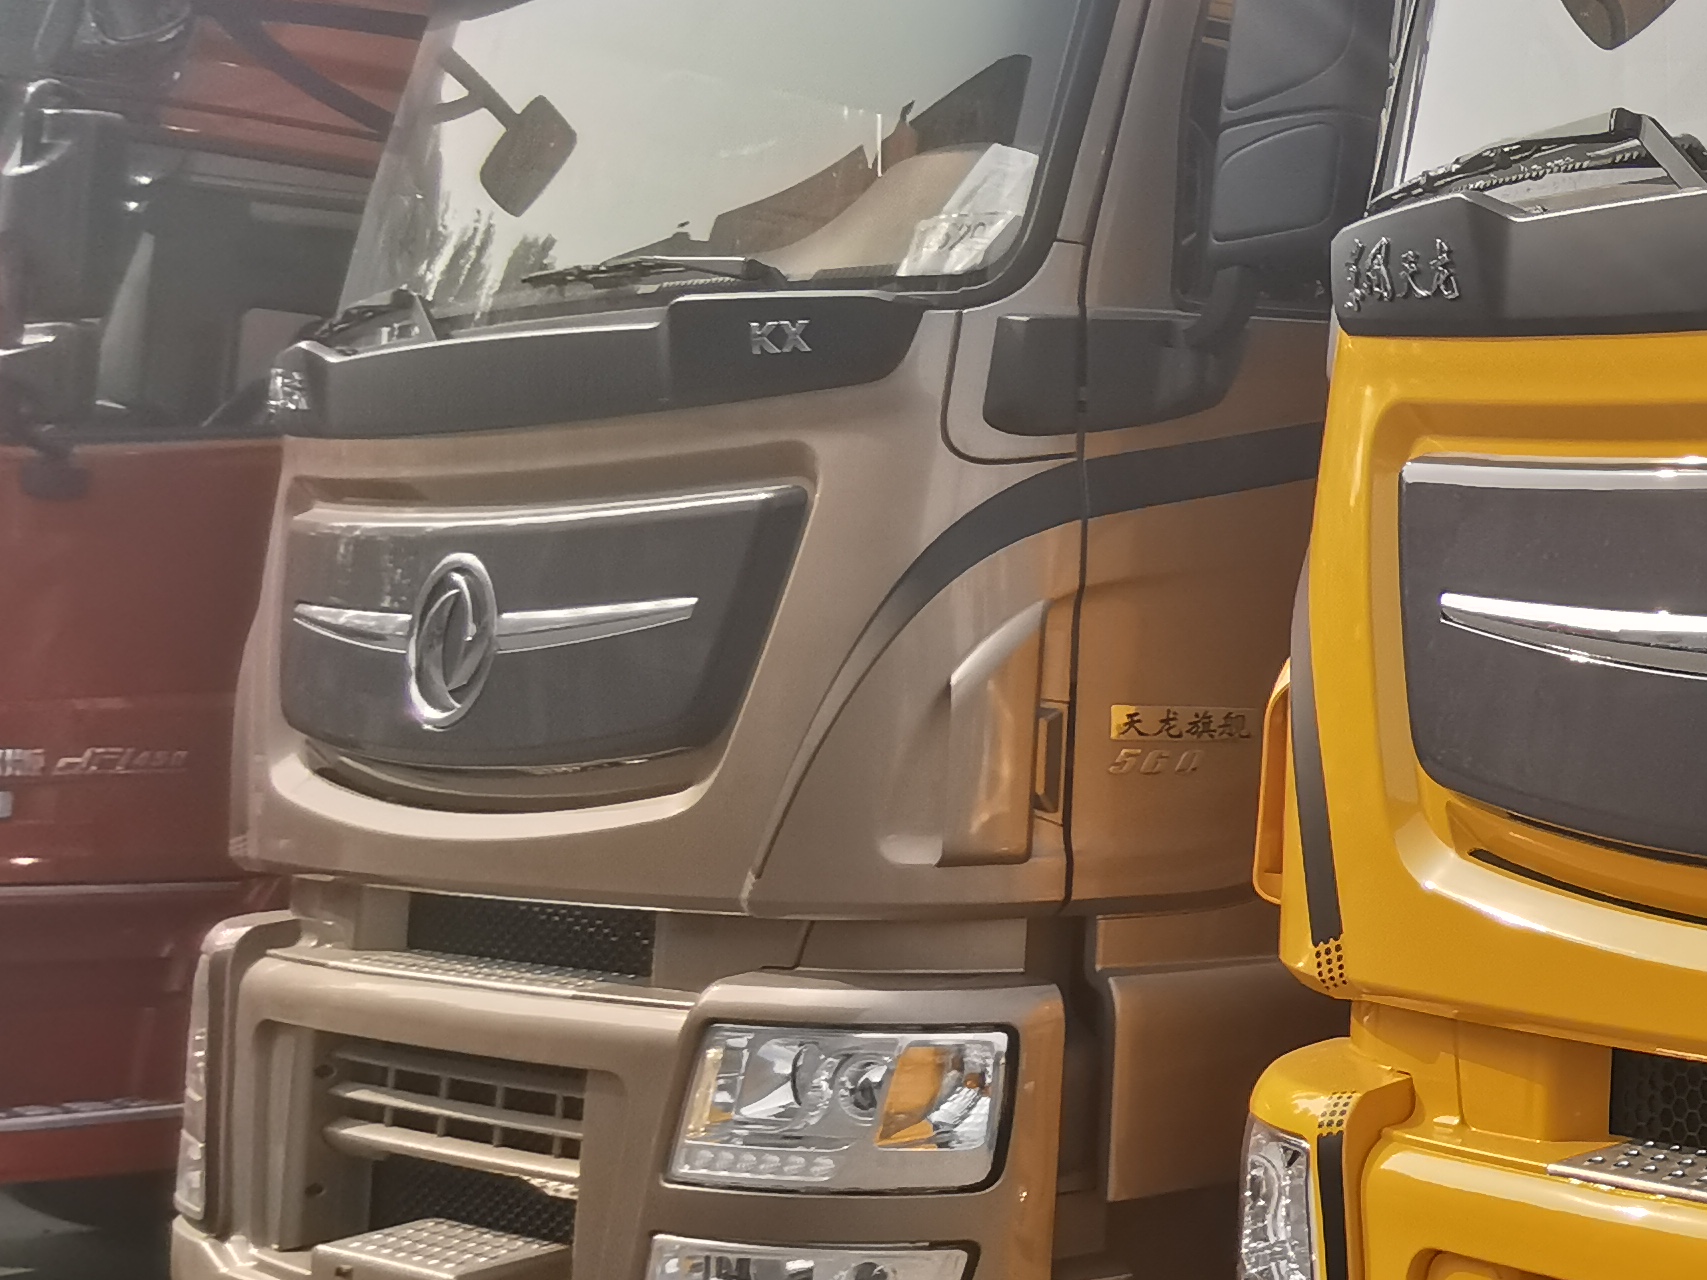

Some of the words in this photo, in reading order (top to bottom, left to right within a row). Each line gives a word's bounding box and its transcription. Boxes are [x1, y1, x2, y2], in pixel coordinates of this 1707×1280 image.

[748, 319, 813, 355] KX
[1119, 708, 1253, 740] 天龙旗舰
